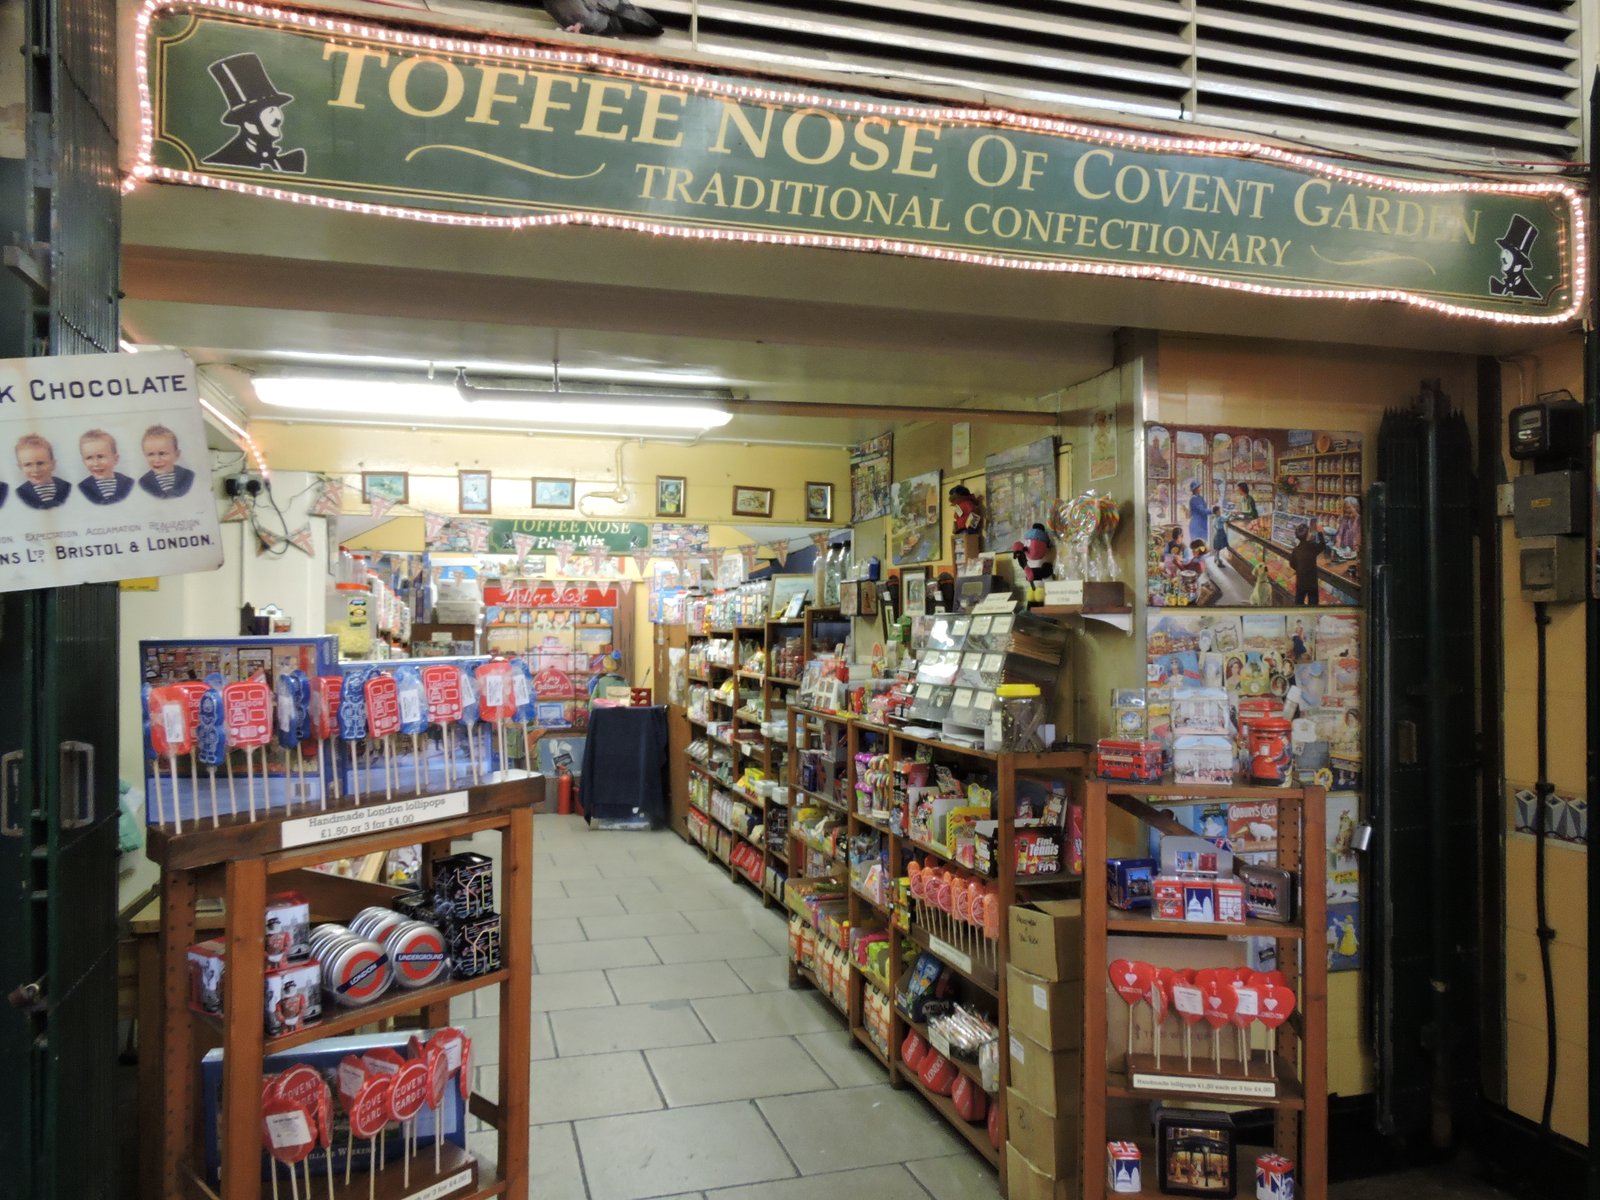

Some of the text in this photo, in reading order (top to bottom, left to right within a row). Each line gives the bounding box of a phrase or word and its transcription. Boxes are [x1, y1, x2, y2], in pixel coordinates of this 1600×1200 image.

[323, 43, 1482, 245] TOFFEE NOSE OF COVENT GARDEN
[635, 163, 1292, 268] TRADITIONAL CONFECTIONARY
[29, 374, 188, 402] CHOCOLATE
[511, 519, 632, 535] TOFFEE NOSE
[56, 543, 124, 560] BRISTOL
[129, 541, 140, 553] &
[309, 797, 446, 828] Handmade London lollipops
[350, 825, 362, 834] or
[364, 822, 370, 832] 3
[372, 819, 387, 830] for
[388, 814, 415, 828] £4.00
[398, 953, 444, 962] UNDERGROUND
[350, 963, 378, 986] LONDON
[394, 1072, 428, 1098] COVENT
[394, 1087, 427, 1112] GARDEN
